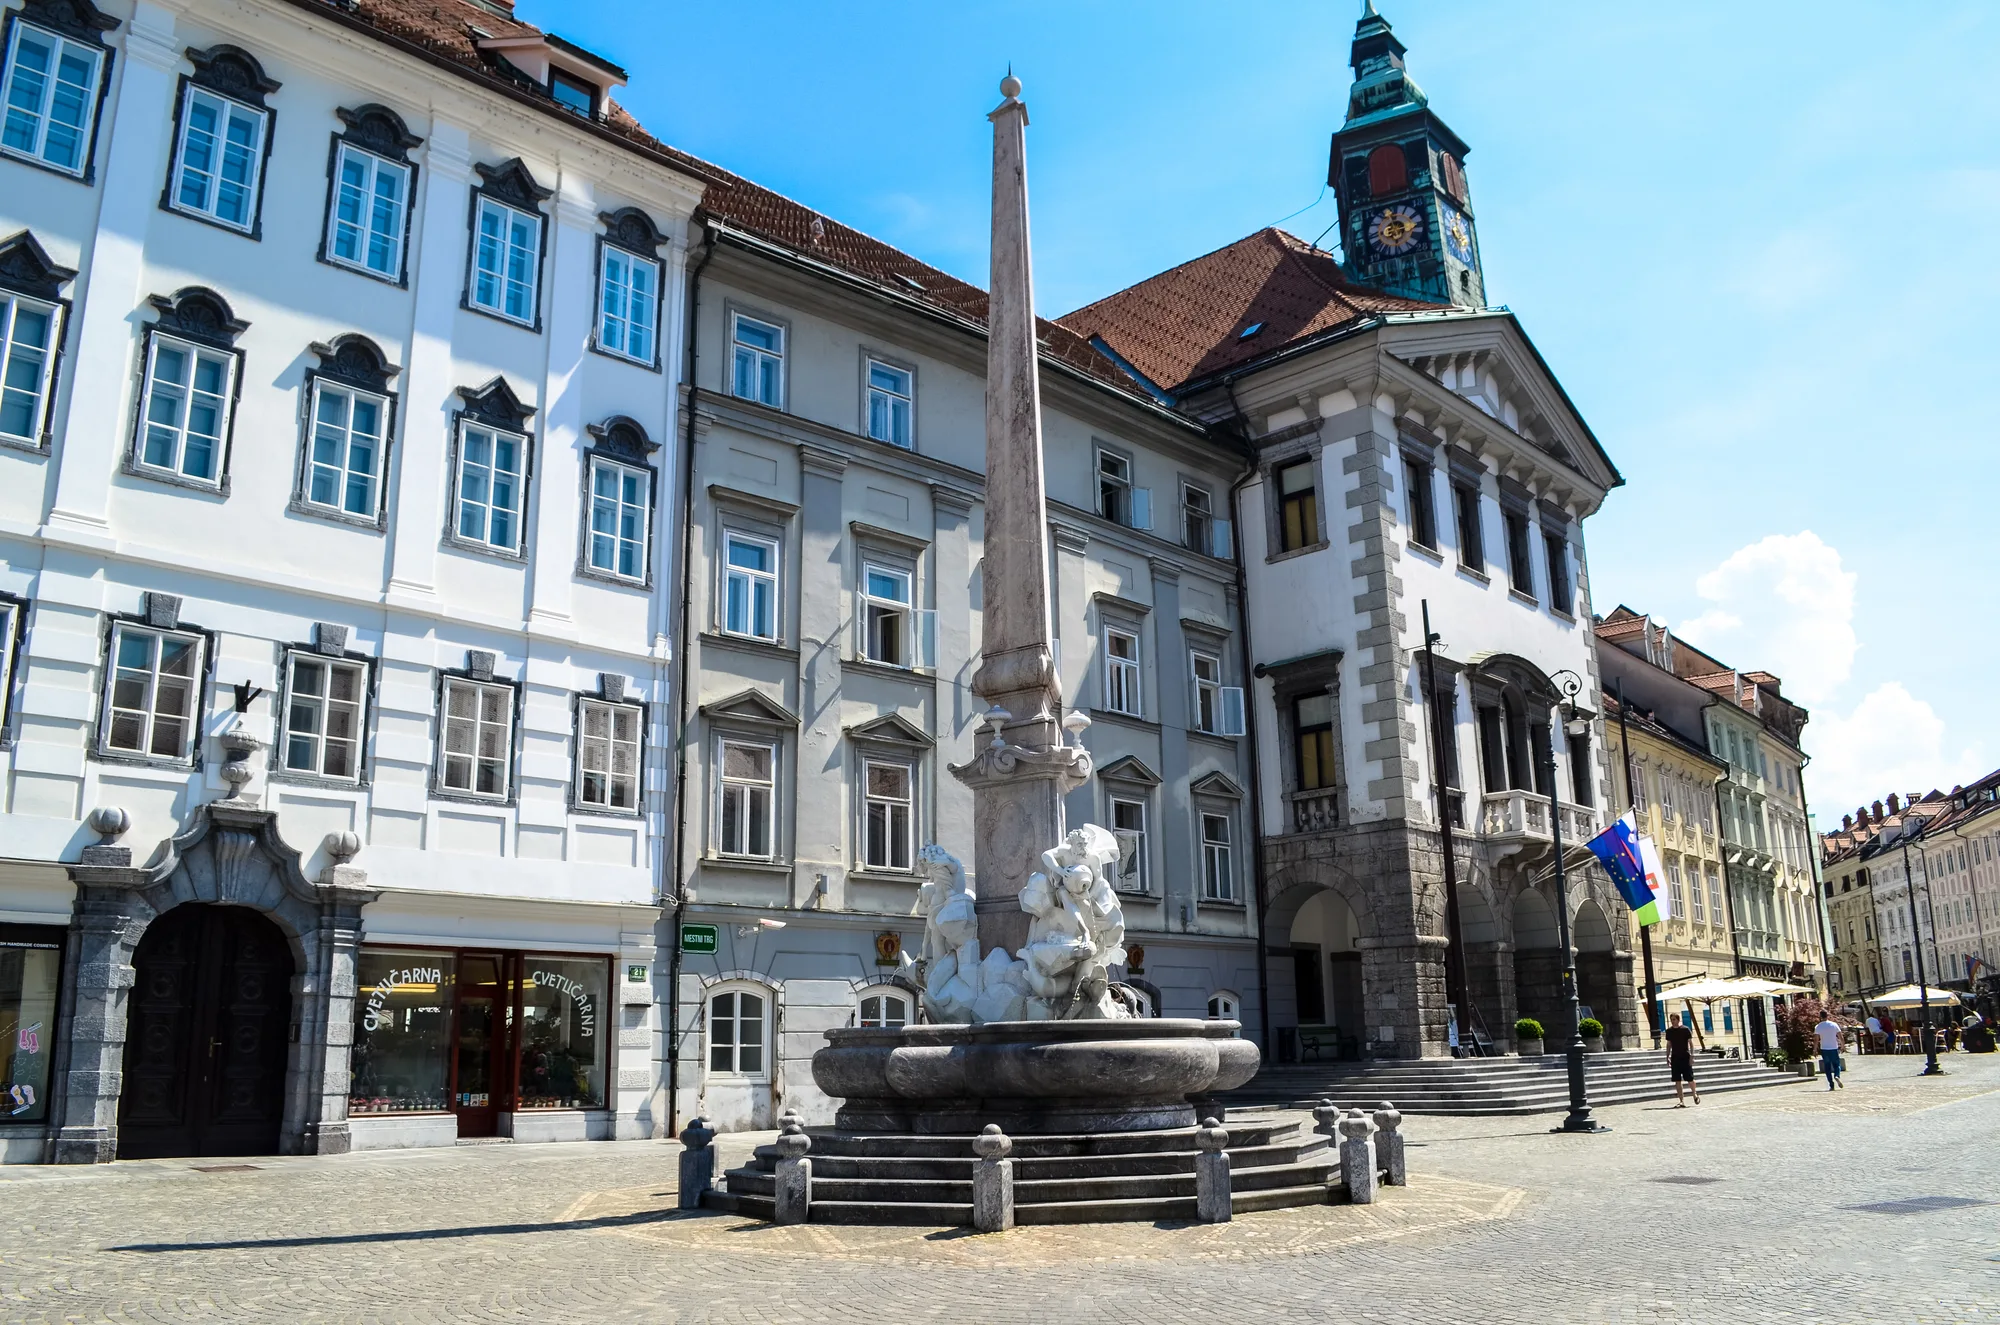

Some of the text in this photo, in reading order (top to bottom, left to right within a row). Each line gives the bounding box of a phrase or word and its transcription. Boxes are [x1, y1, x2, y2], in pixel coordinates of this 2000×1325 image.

[684, 934, 714, 944] MESTNI TRG
[634, 968, 642, 976] 21
[363, 967, 441, 1031] CVETLIČARNA
[532, 970, 594, 1037] CVETLIČARNA
